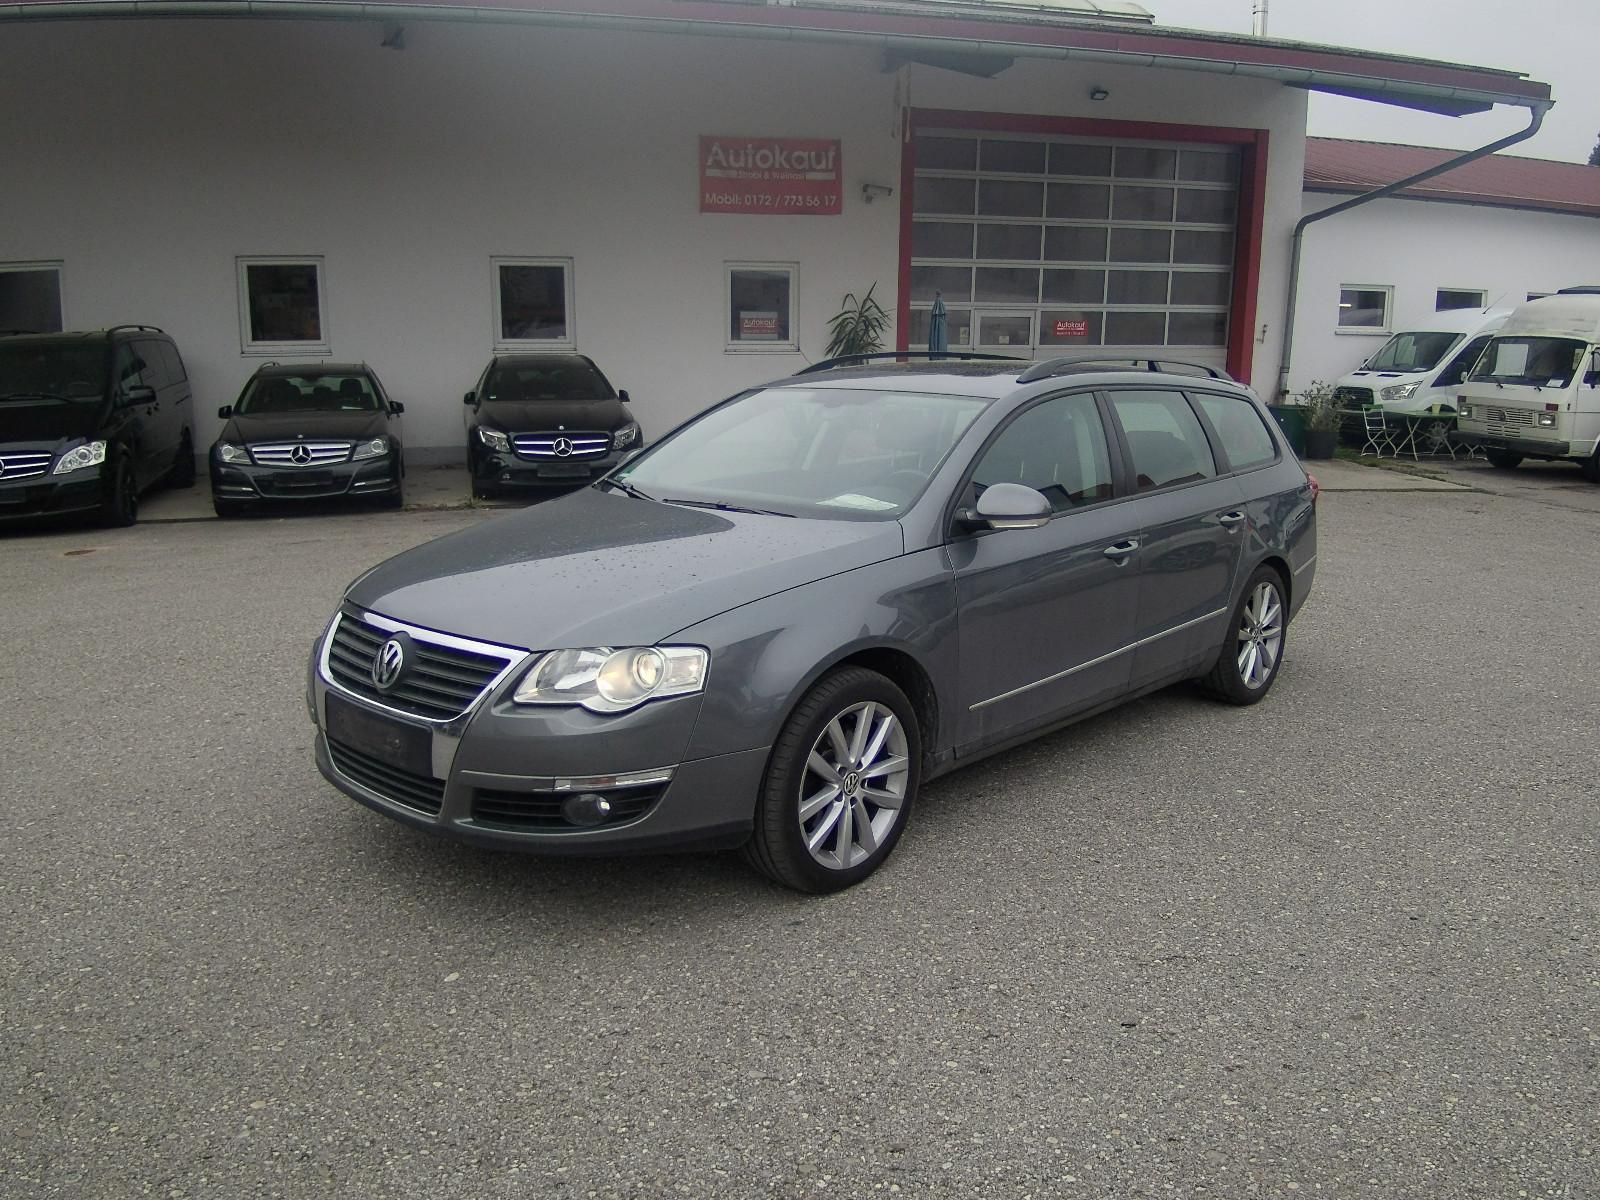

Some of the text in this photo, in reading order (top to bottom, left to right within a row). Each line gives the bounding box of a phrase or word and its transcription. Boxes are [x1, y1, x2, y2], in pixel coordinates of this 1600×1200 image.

[706, 142, 836, 169] Autokauf
[705, 192, 741, 204] Mobil:
[744, 194, 772, 206] 0172
[783, 195, 804, 206] 773
[806, 195, 820, 206] 56
[825, 195, 836, 206] 17
